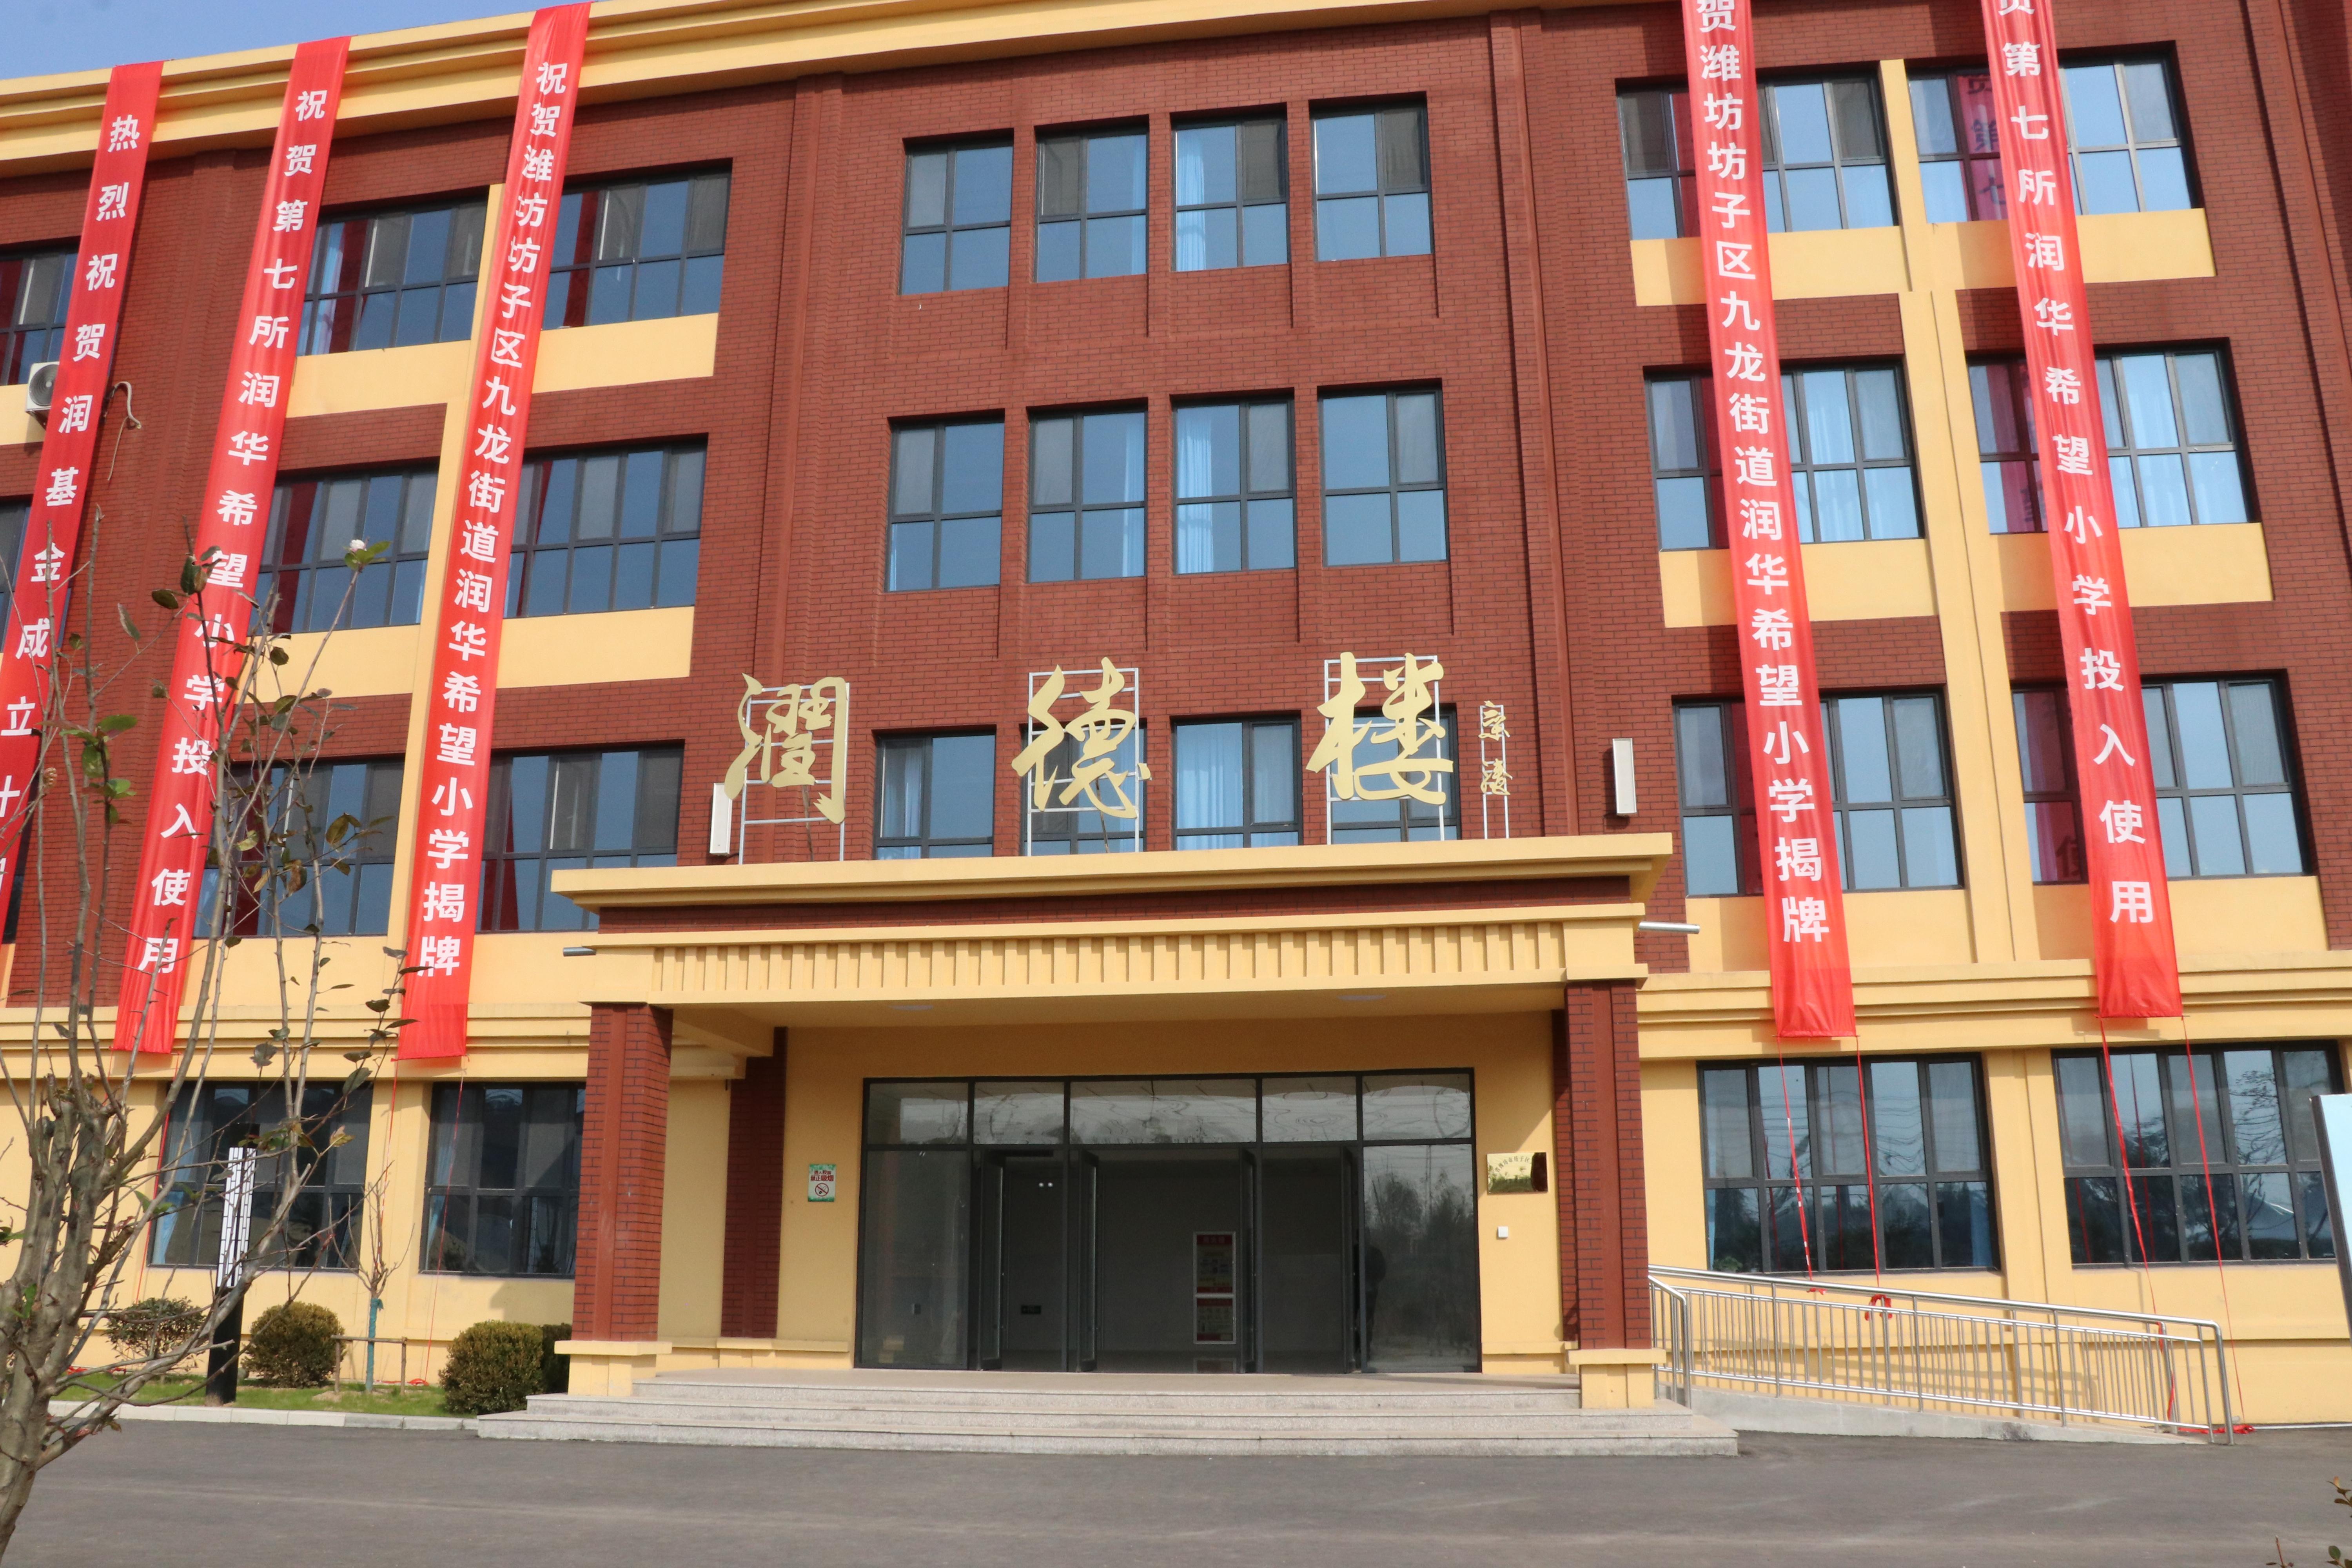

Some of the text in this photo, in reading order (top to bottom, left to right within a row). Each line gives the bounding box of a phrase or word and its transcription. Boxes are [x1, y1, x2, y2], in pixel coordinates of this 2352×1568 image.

[0, 114, 140, 895] 热烈祝贺润基金成立十
[137, 90, 327, 974] 祝贺第七所润华希望小学投入使用
[417, 62, 568, 977] 祝贺潍坊坊子区九龙街道润华希望小学揭牌
